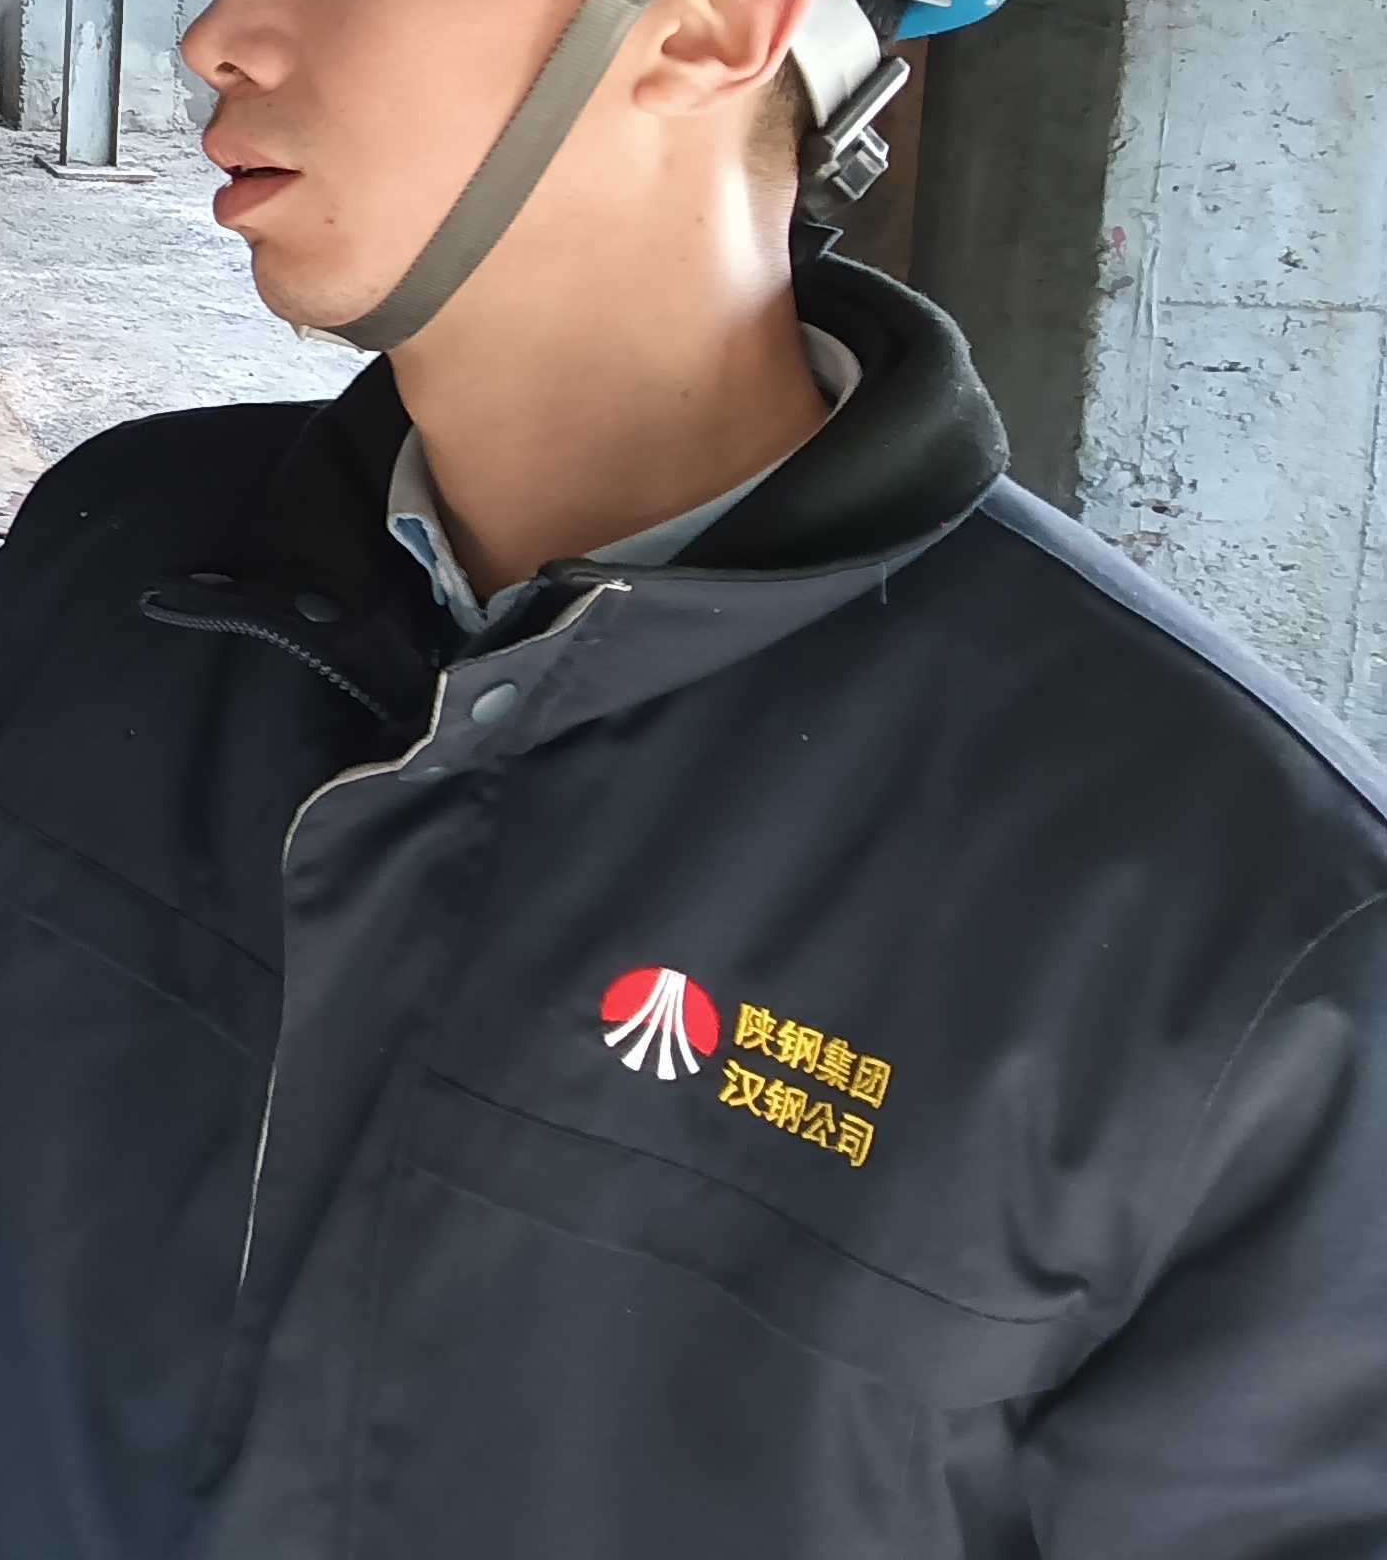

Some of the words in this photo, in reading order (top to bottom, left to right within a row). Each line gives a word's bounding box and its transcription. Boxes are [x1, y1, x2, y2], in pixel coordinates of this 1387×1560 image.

[734, 1002, 893, 1109] 陕钢集团
[718, 1059, 875, 1167] 汉钢公司
